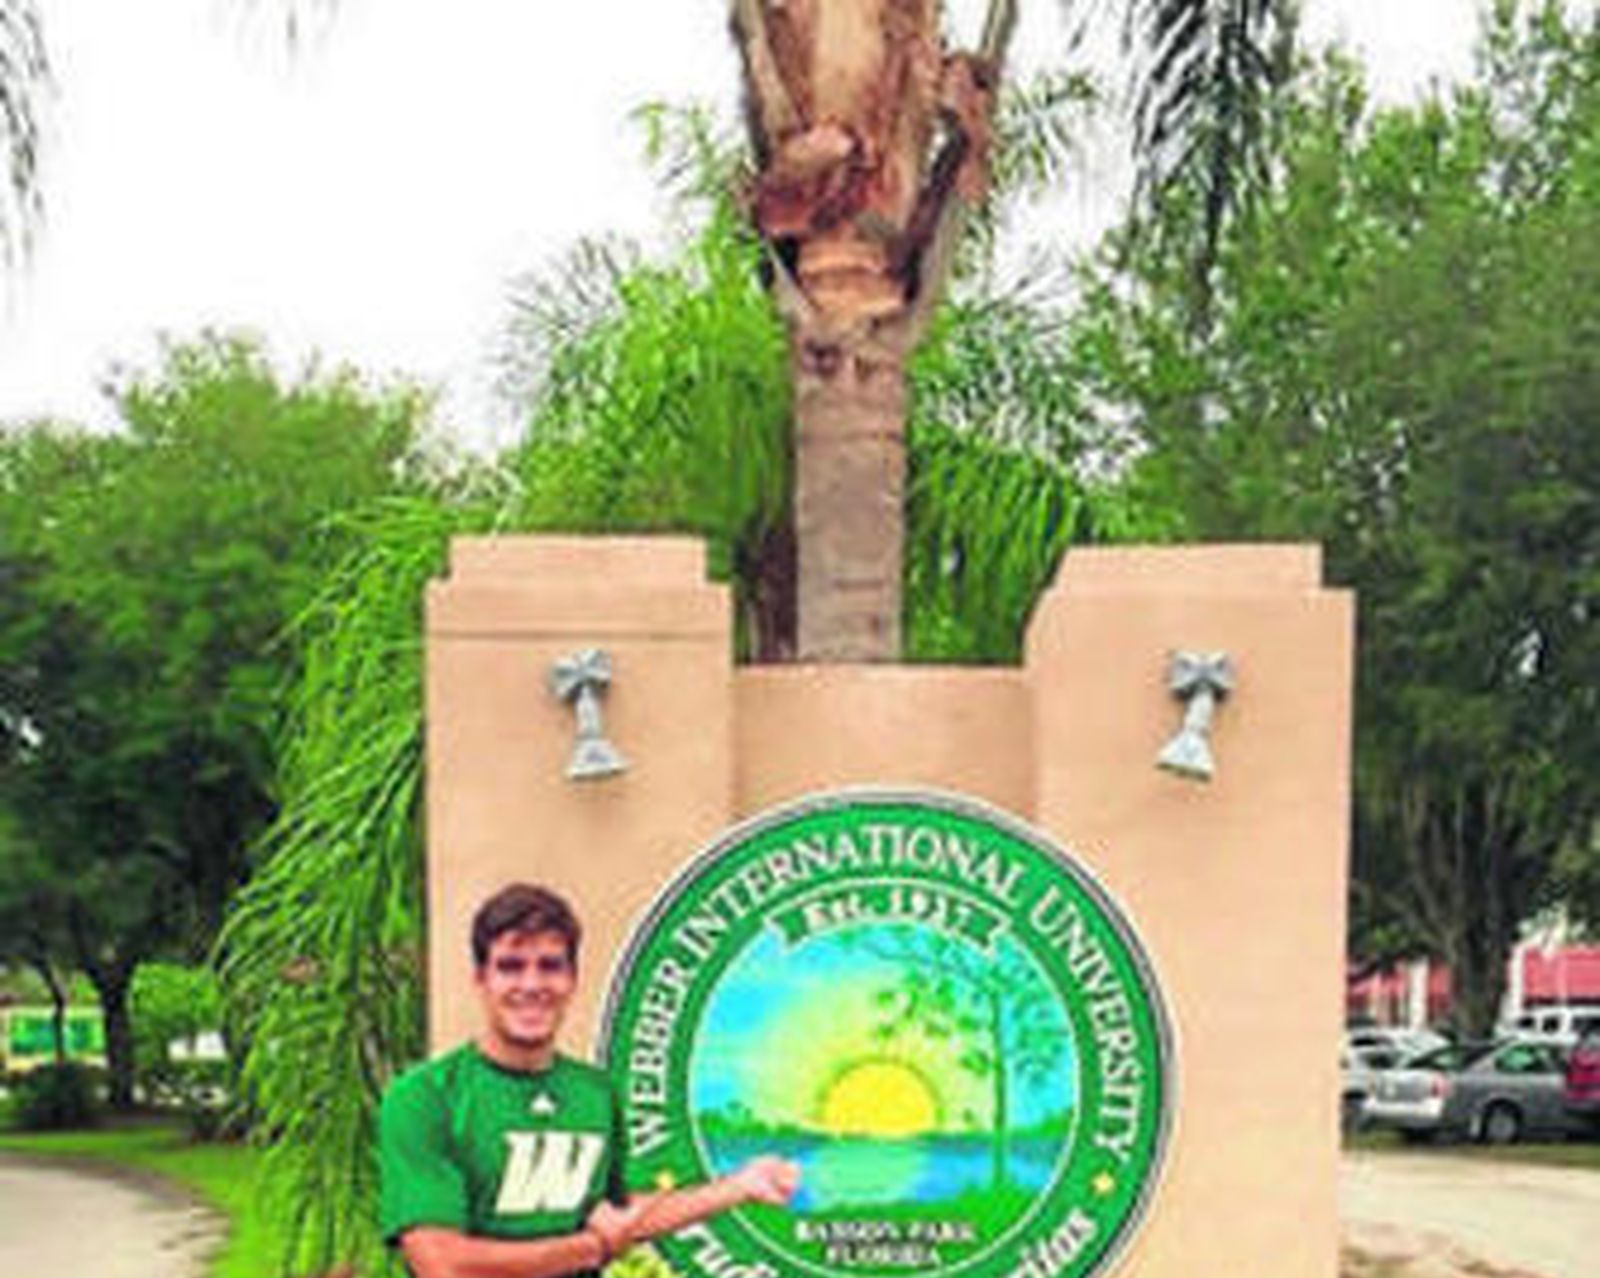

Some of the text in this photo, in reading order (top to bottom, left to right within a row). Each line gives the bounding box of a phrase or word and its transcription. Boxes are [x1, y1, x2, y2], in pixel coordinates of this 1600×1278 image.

[628, 828, 1142, 1163] WEBBER INTERNATIONAL UNIVERSITY
[496, 1131, 605, 1213] W
